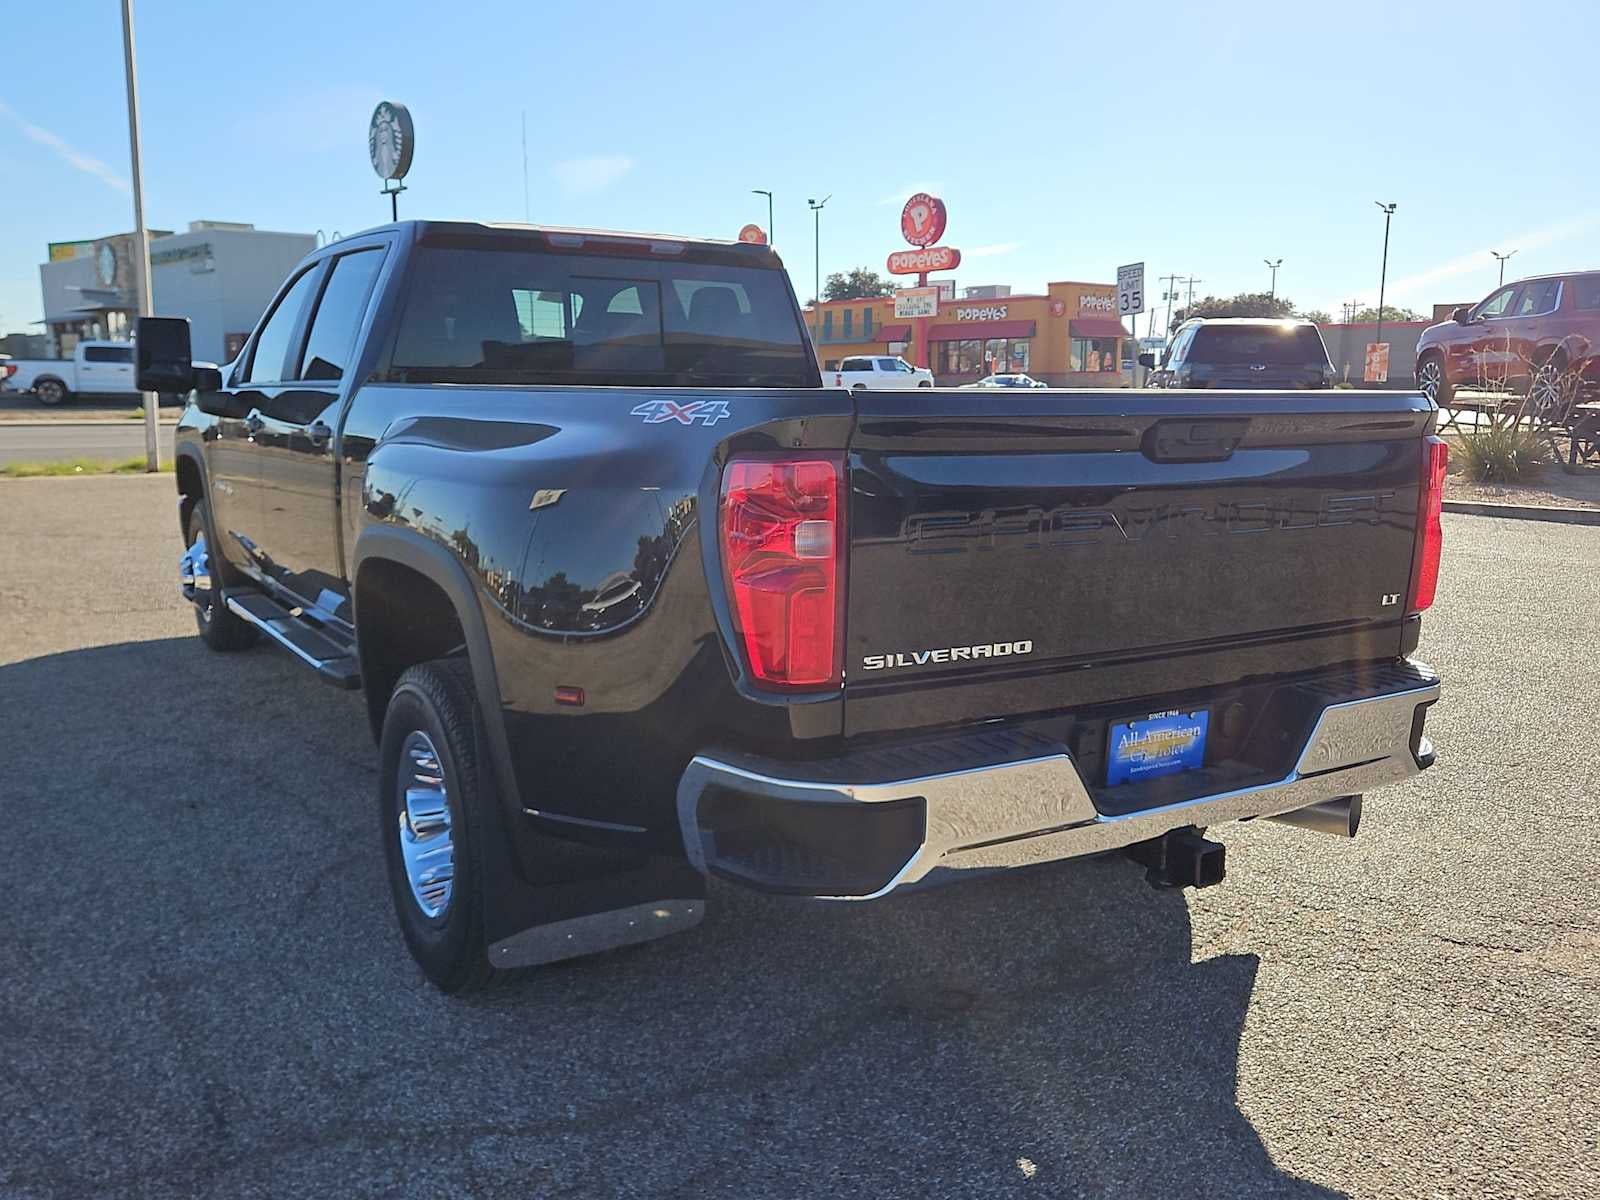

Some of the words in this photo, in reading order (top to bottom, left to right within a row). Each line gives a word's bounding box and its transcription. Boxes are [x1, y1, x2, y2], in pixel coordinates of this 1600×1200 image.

[1119, 269, 1142, 280] SPEED
[1121, 279, 1139, 291] LIMIT
[1120, 291, 1142, 311] 35
[1381, 593, 1400, 606] LT
[862, 639, 1033, 670] SILVERADO
[1118, 731, 1139, 749] All
[1142, 725, 1201, 744] American
